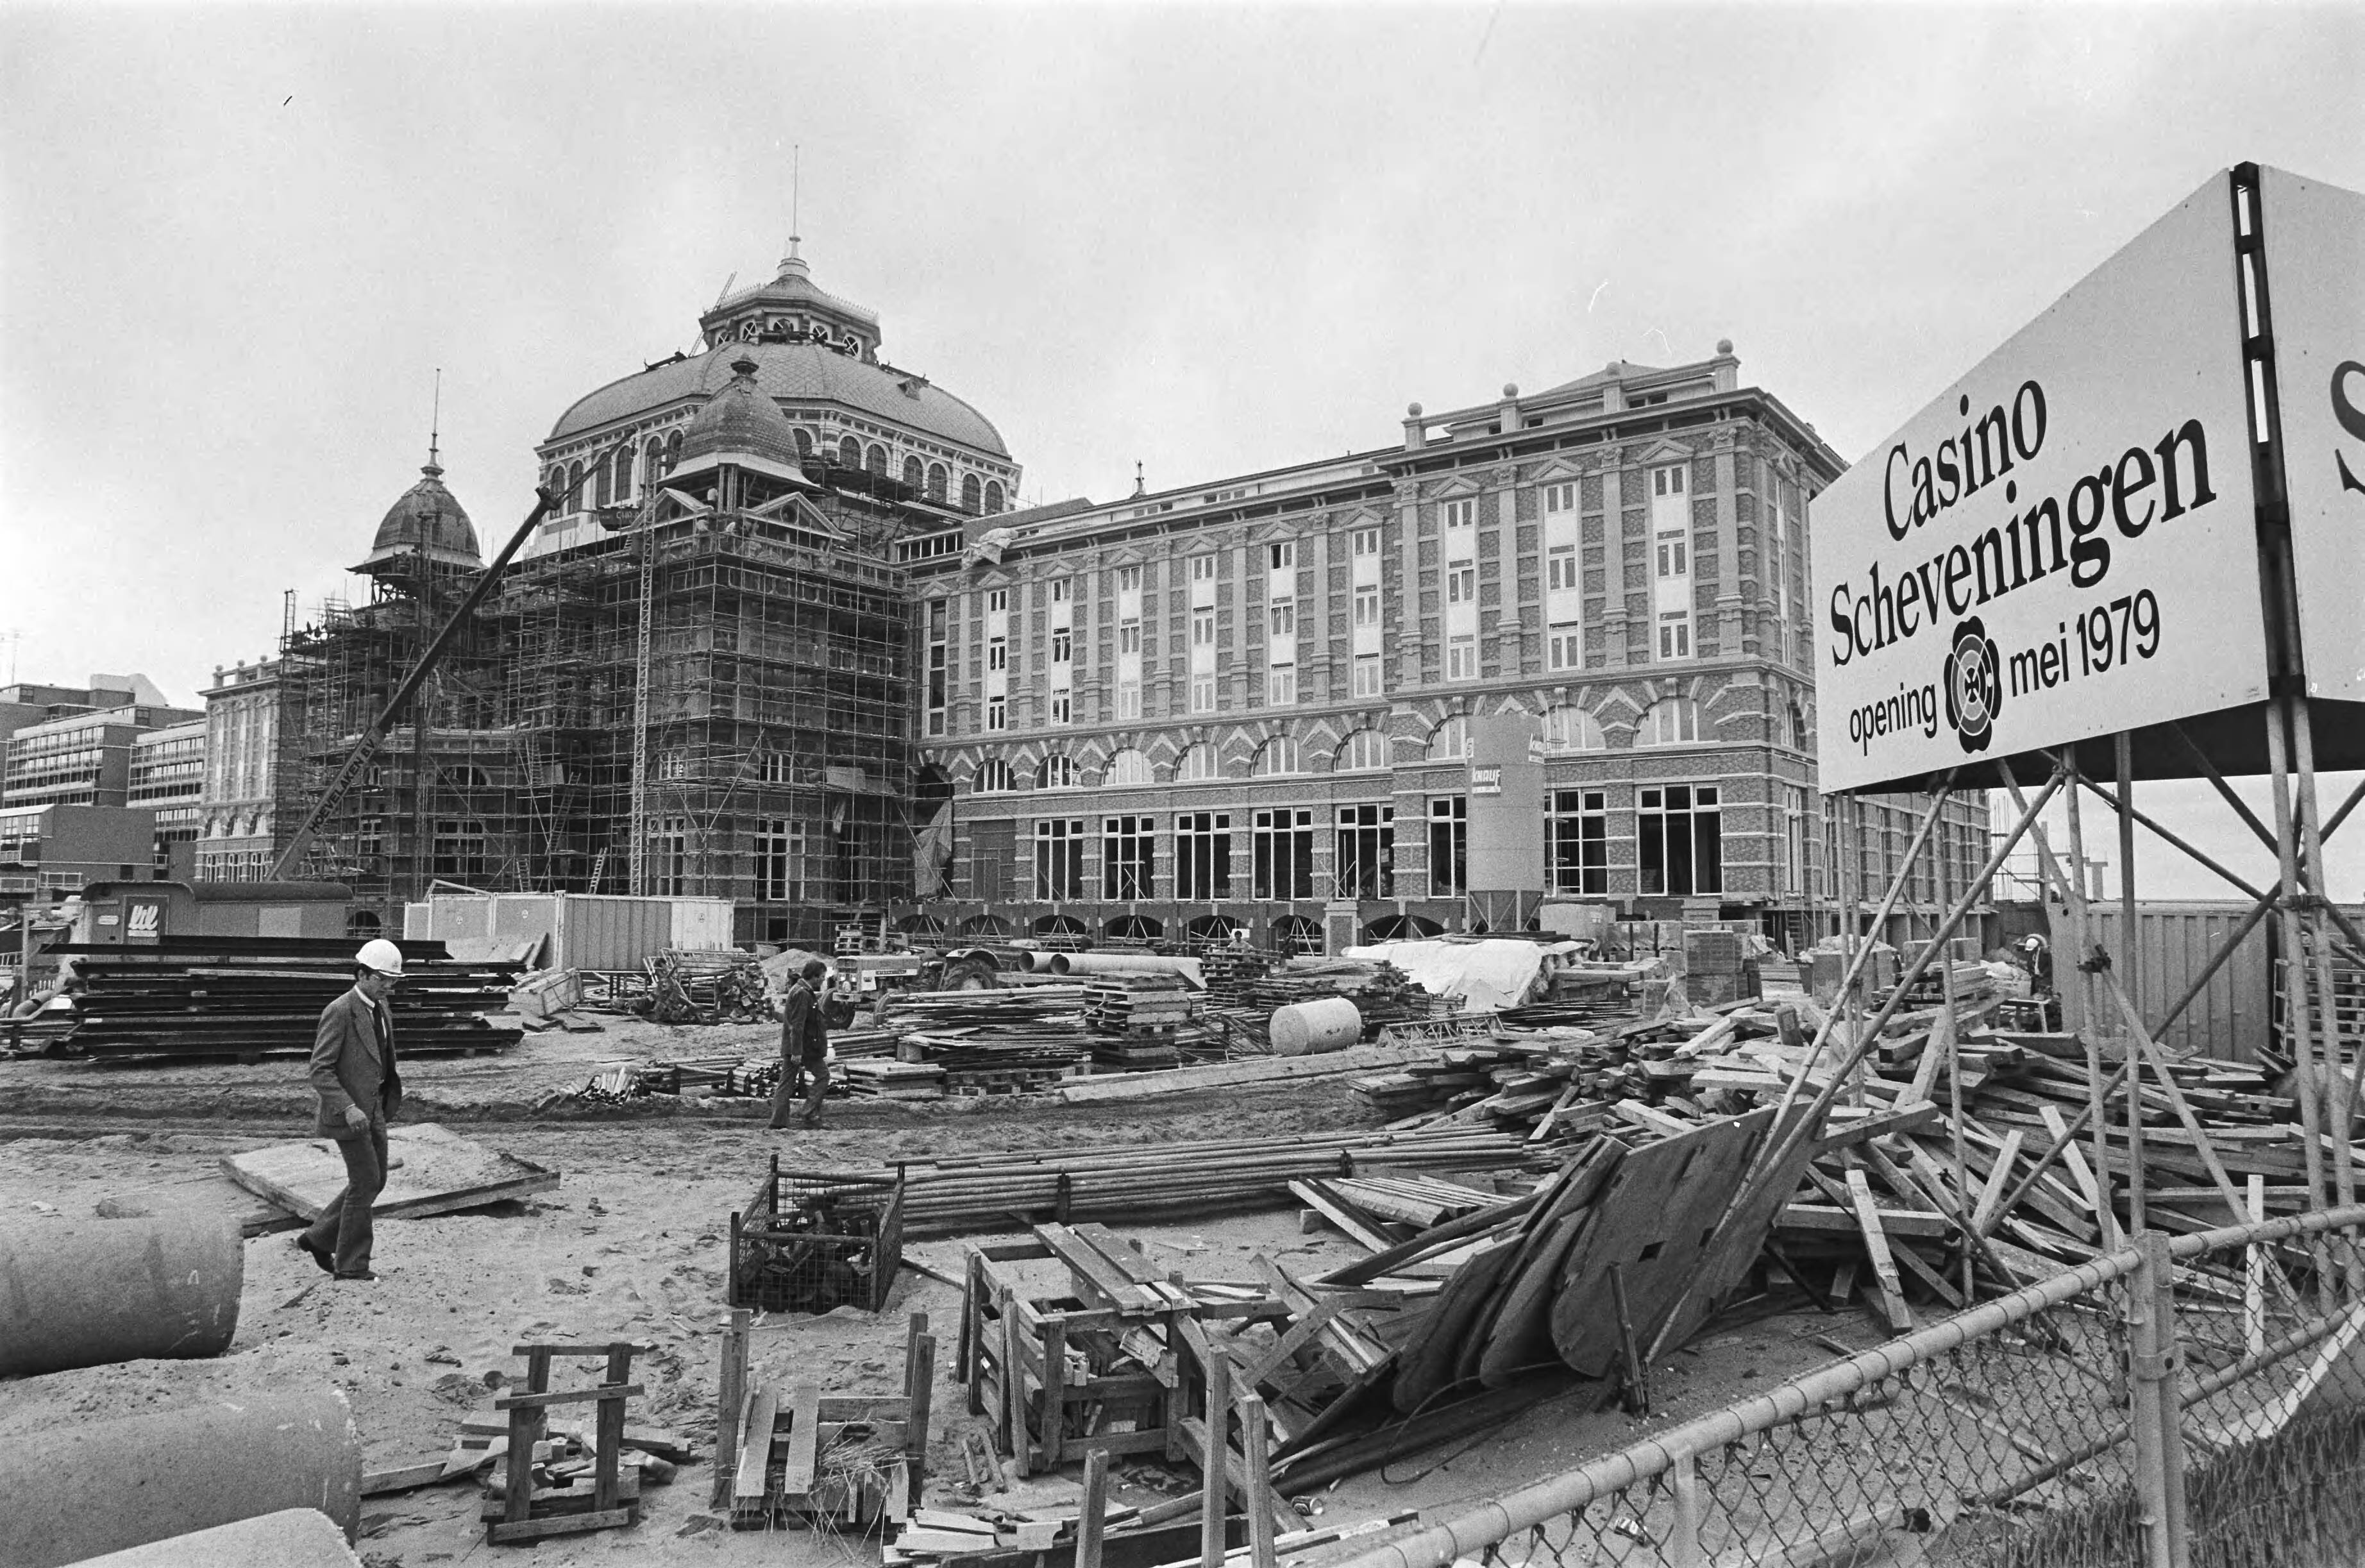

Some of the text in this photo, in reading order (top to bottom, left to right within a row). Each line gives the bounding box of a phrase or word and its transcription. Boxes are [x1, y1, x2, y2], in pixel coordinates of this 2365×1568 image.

[1884, 380, 2048, 542] Casino
[1830, 418, 2217, 668] Scheveningen
[1849, 588, 2161, 757] opening mei 1979
[308, 757, 364, 833] HOEVELAKEN
[1472, 769, 1501, 786] KNAUF
